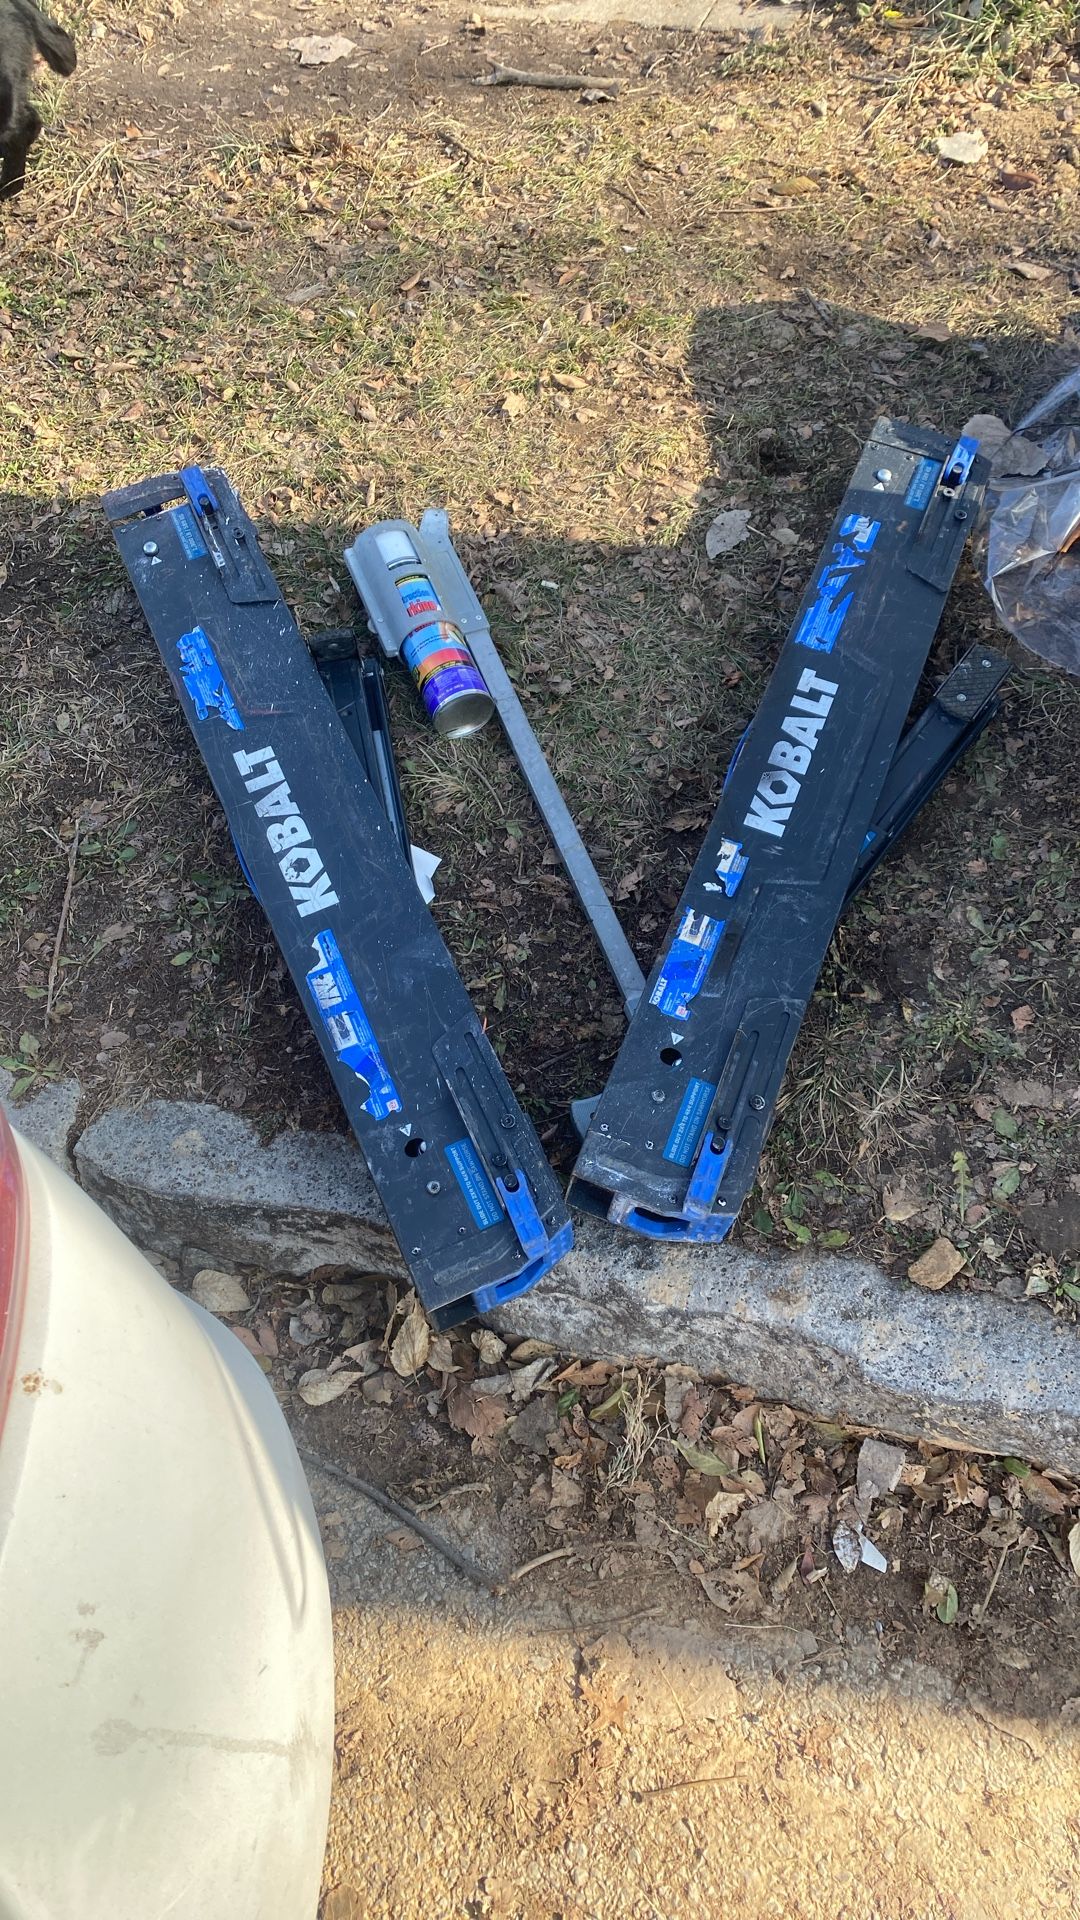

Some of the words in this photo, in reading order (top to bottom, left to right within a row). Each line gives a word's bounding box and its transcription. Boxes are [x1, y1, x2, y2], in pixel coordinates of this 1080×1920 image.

[743, 667, 839, 838] KOBALT
[232, 745, 341, 918] KOBALT
[694, 1086, 712, 1116] SAWHORSE
[668, 1143, 678, 1158] SLIDE
[673, 1132, 682, 1144] OUT
[688, 1082, 701, 1105] SUPPORT
[692, 1115, 700, 1125] ON
[685, 1124, 698, 1143] STAND
[681, 1142, 691, 1154] NOT
[450, 1147, 465, 1170] SUPPORT
[460, 1143, 477, 1172] SAWHORSE
[678, 1153, 687, 1163] DO
[465, 1180, 472, 1188] TO
[473, 1172, 482, 1182] ON
[477, 1181, 490, 1200] STAND
[473, 1198, 482, 1210] OUT
[485, 1199, 495, 1211] NOT
[477, 1209, 489, 1225] SLIDE
[491, 1211, 499, 1220] DO
